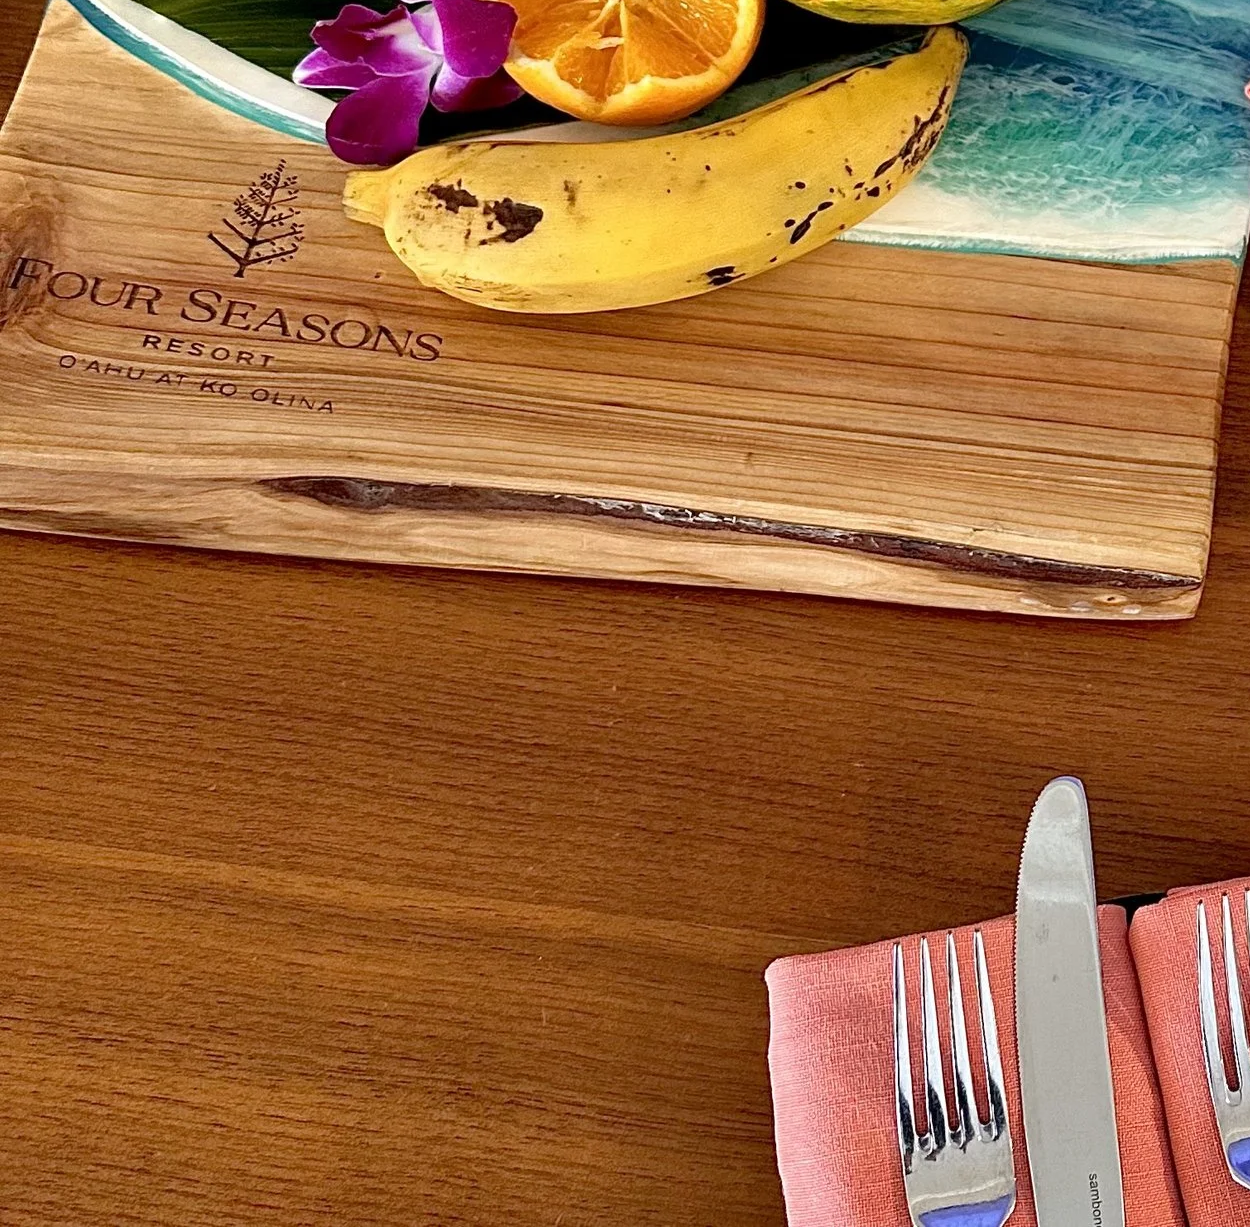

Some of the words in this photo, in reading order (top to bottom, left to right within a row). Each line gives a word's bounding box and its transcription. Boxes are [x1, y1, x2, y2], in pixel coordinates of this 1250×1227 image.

[7, 256, 163, 315] FOUR
[180, 289, 443, 362] SEASONS
[143, 334, 276, 368] RESORT
[155, 373, 188, 387] AT
[200, 379, 238, 397] KO
[251, 387, 334, 414] OLINA
[1088, 1173, 1103, 1227] sambon
